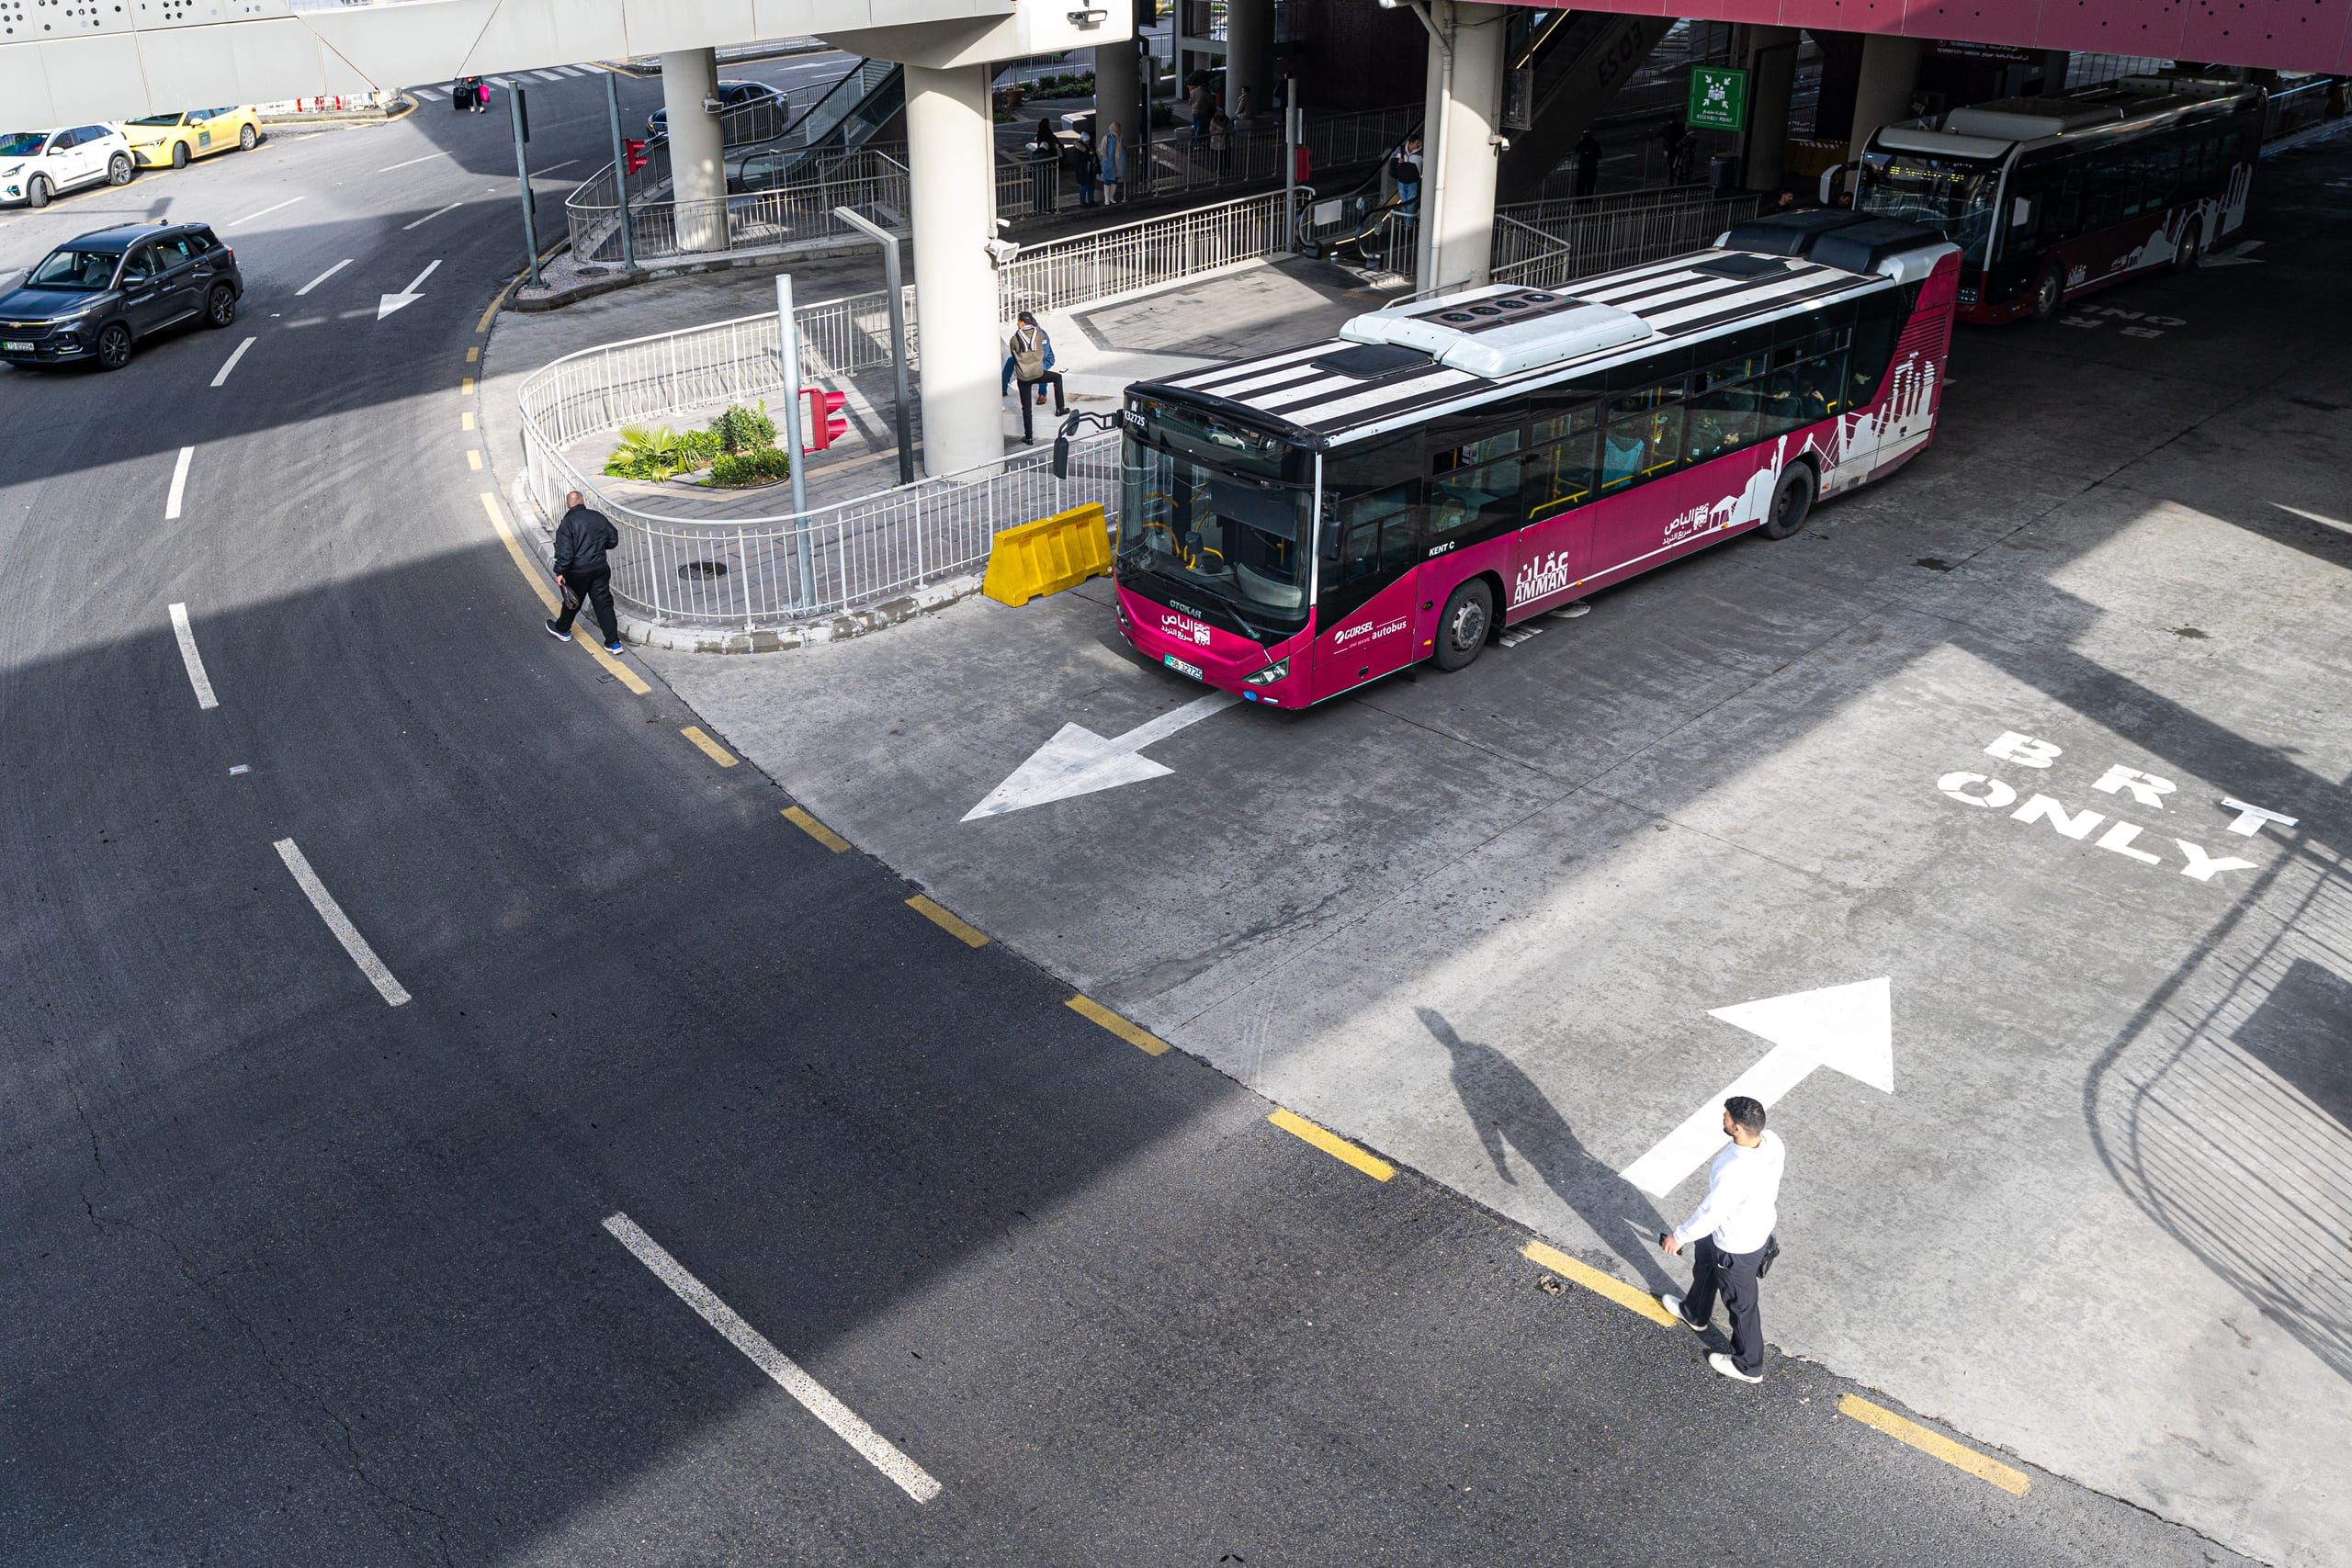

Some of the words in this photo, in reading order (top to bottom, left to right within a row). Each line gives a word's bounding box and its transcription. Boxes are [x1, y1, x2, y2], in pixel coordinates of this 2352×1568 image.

[1429, 542, 1448, 558] KENT
[1449, 540, 1455, 550] C
[1513, 567, 1568, 604] AMMAN
[1170, 600, 1202, 619] OTOKAR
[1161, 615, 1193, 633] الباص
[1372, 620, 1407, 640] autobus
[1937, 771, 2259, 883] ONLY
